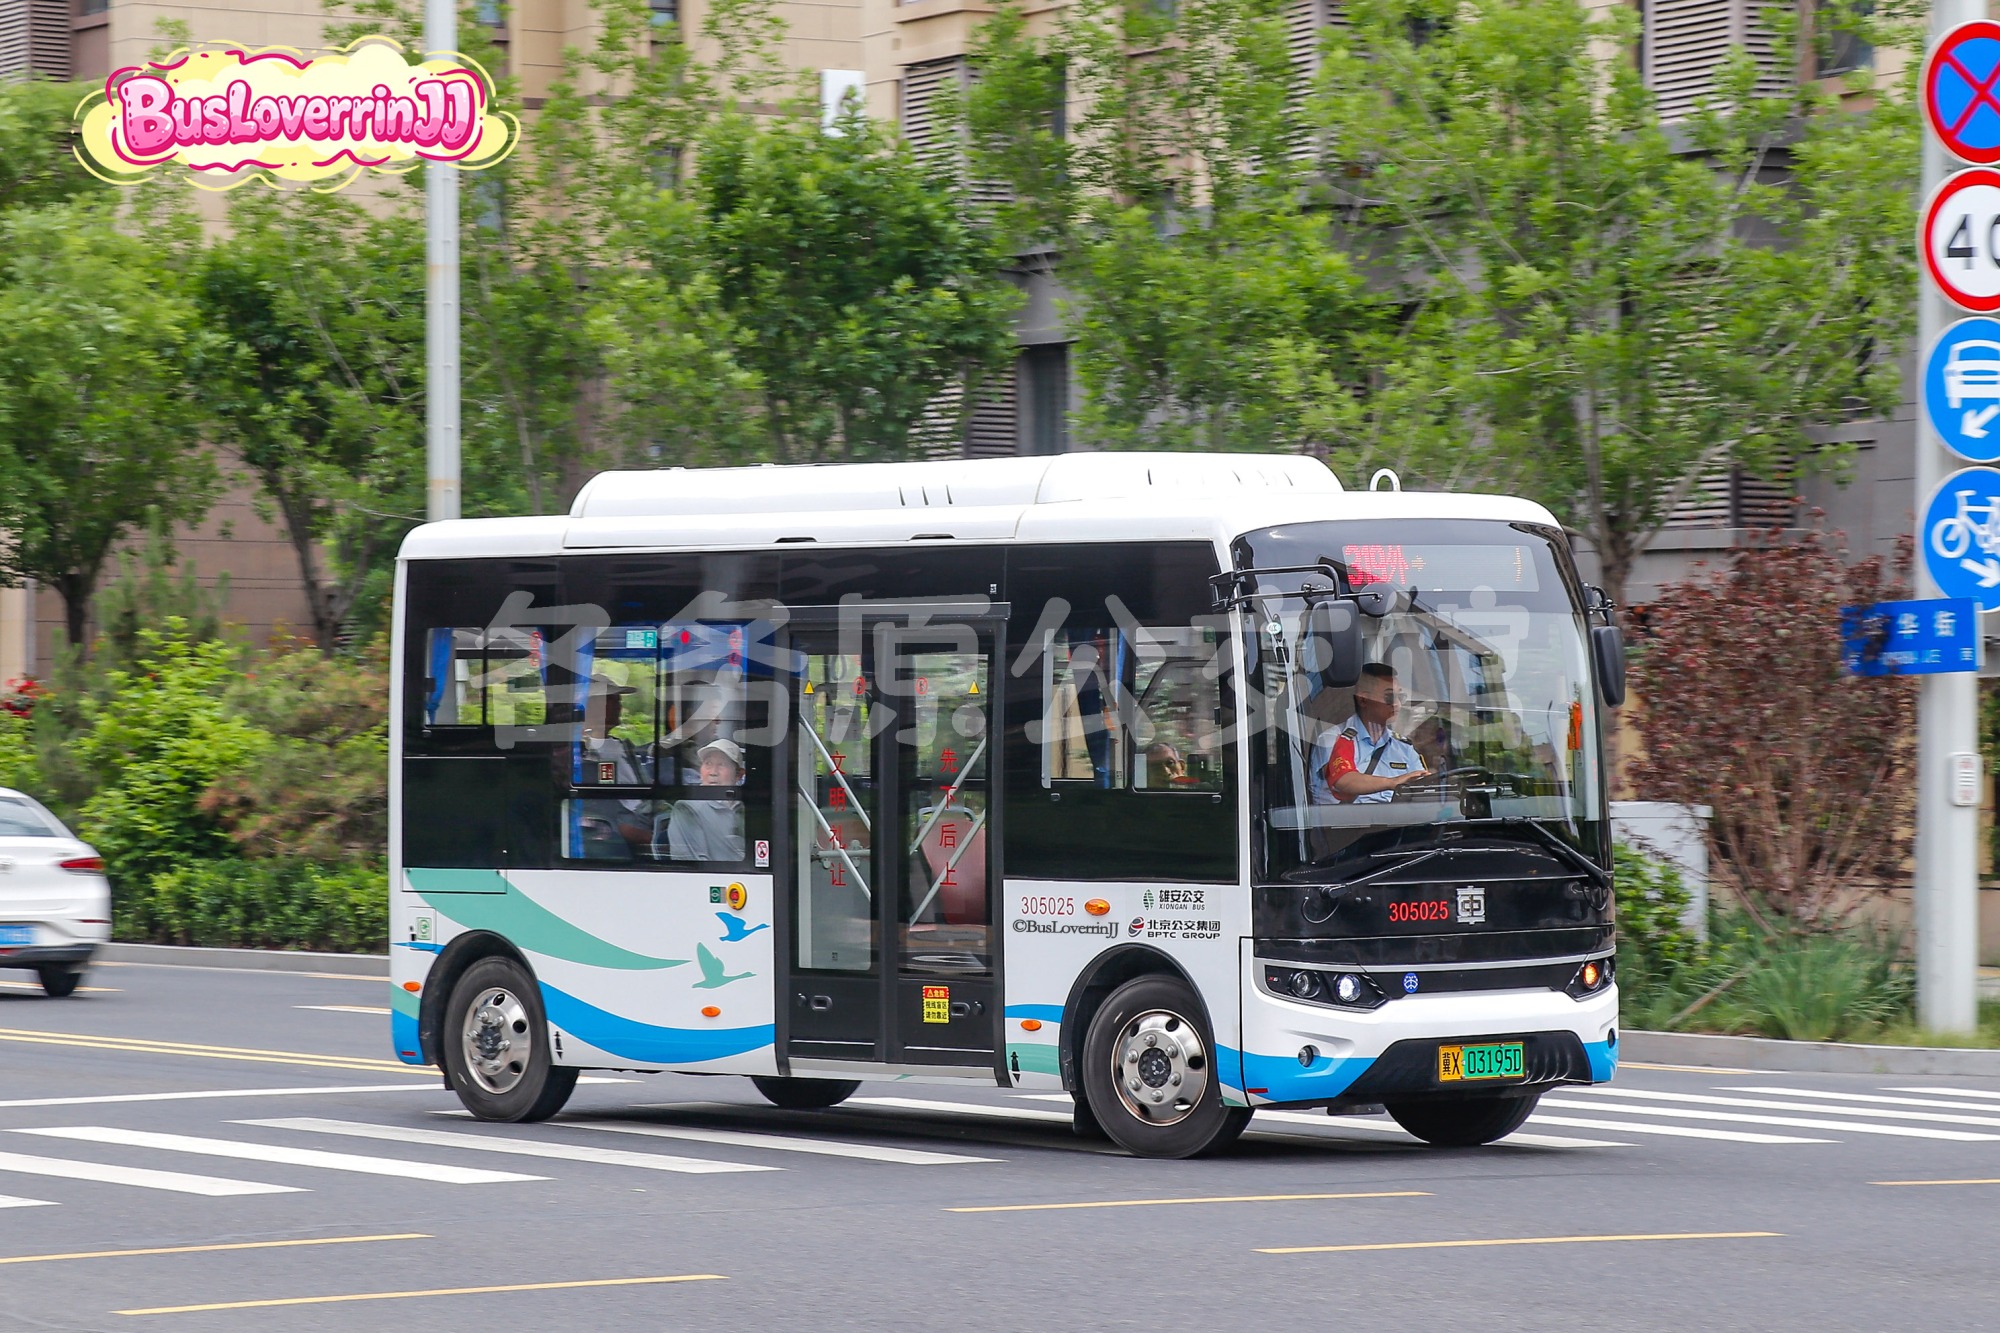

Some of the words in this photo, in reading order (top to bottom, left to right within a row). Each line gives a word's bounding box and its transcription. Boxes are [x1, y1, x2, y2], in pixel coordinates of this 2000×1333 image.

[829, 750, 847, 887] 文明礼让
[939, 748, 958, 886] 先下后上
[1158, 889, 1205, 903] 雄安公交
[1021, 896, 1075, 916] 305025
[1158, 903, 1188, 911] XIONGAN
[1389, 901, 1449, 921] 305025
[1147, 919, 1221, 932] 北京公交集团
[1147, 931, 1177, 939] BPTC
[1182, 932, 1221, 940] GROUP
